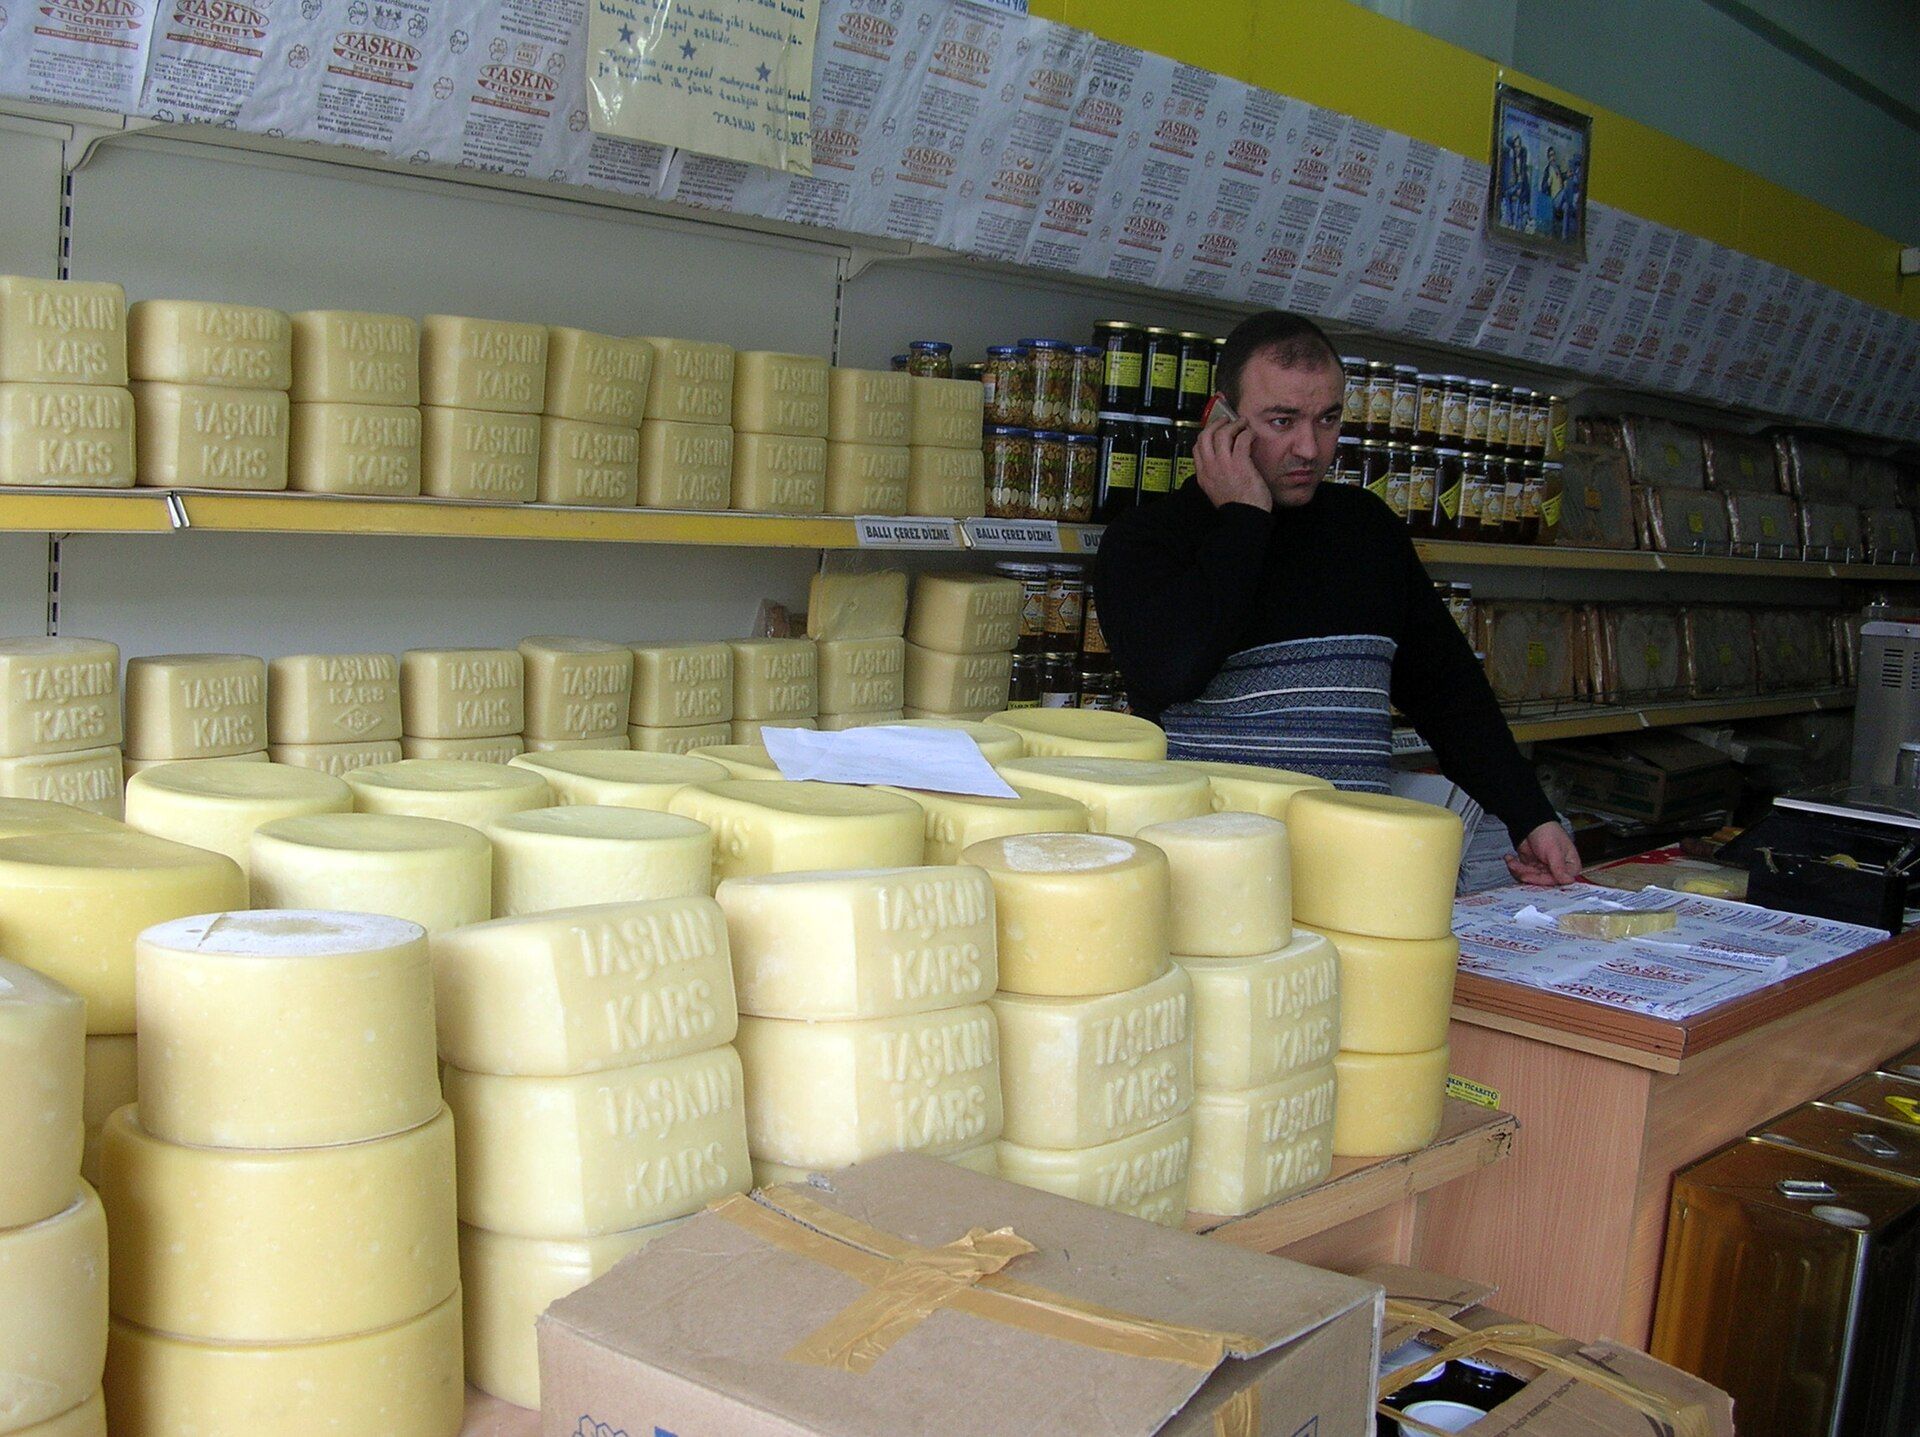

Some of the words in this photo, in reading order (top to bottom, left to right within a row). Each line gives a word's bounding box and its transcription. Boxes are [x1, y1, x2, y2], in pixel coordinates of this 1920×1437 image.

[37, 339, 108, 374] KARS
[203, 347, 273, 378] KARS
[350, 361, 407, 392] KARS
[476, 370, 531, 400] KARS
[39, 440, 114, 475] KARS
[203, 445, 267, 479] KARS
[347, 455, 409, 486] KARS
[471, 462, 524, 492] KARS
[866, 524, 893, 539] BALLI
[894, 527, 921, 544] ÇEREZ
[921, 524, 950, 541] DİZME
[975, 526, 1000, 541] BALLI
[1001, 529, 1027, 544] ÇEREZ
[1027, 526, 1053, 542] DİZME
[893, 943, 982, 999] KARS
[605, 979, 715, 1052] KARS
[1105, 1061, 1178, 1128] KARS
[897, 1085, 986, 1152] KARS
[626, 1141, 728, 1210] KARS
[1265, 1139, 1322, 1196] KARS
